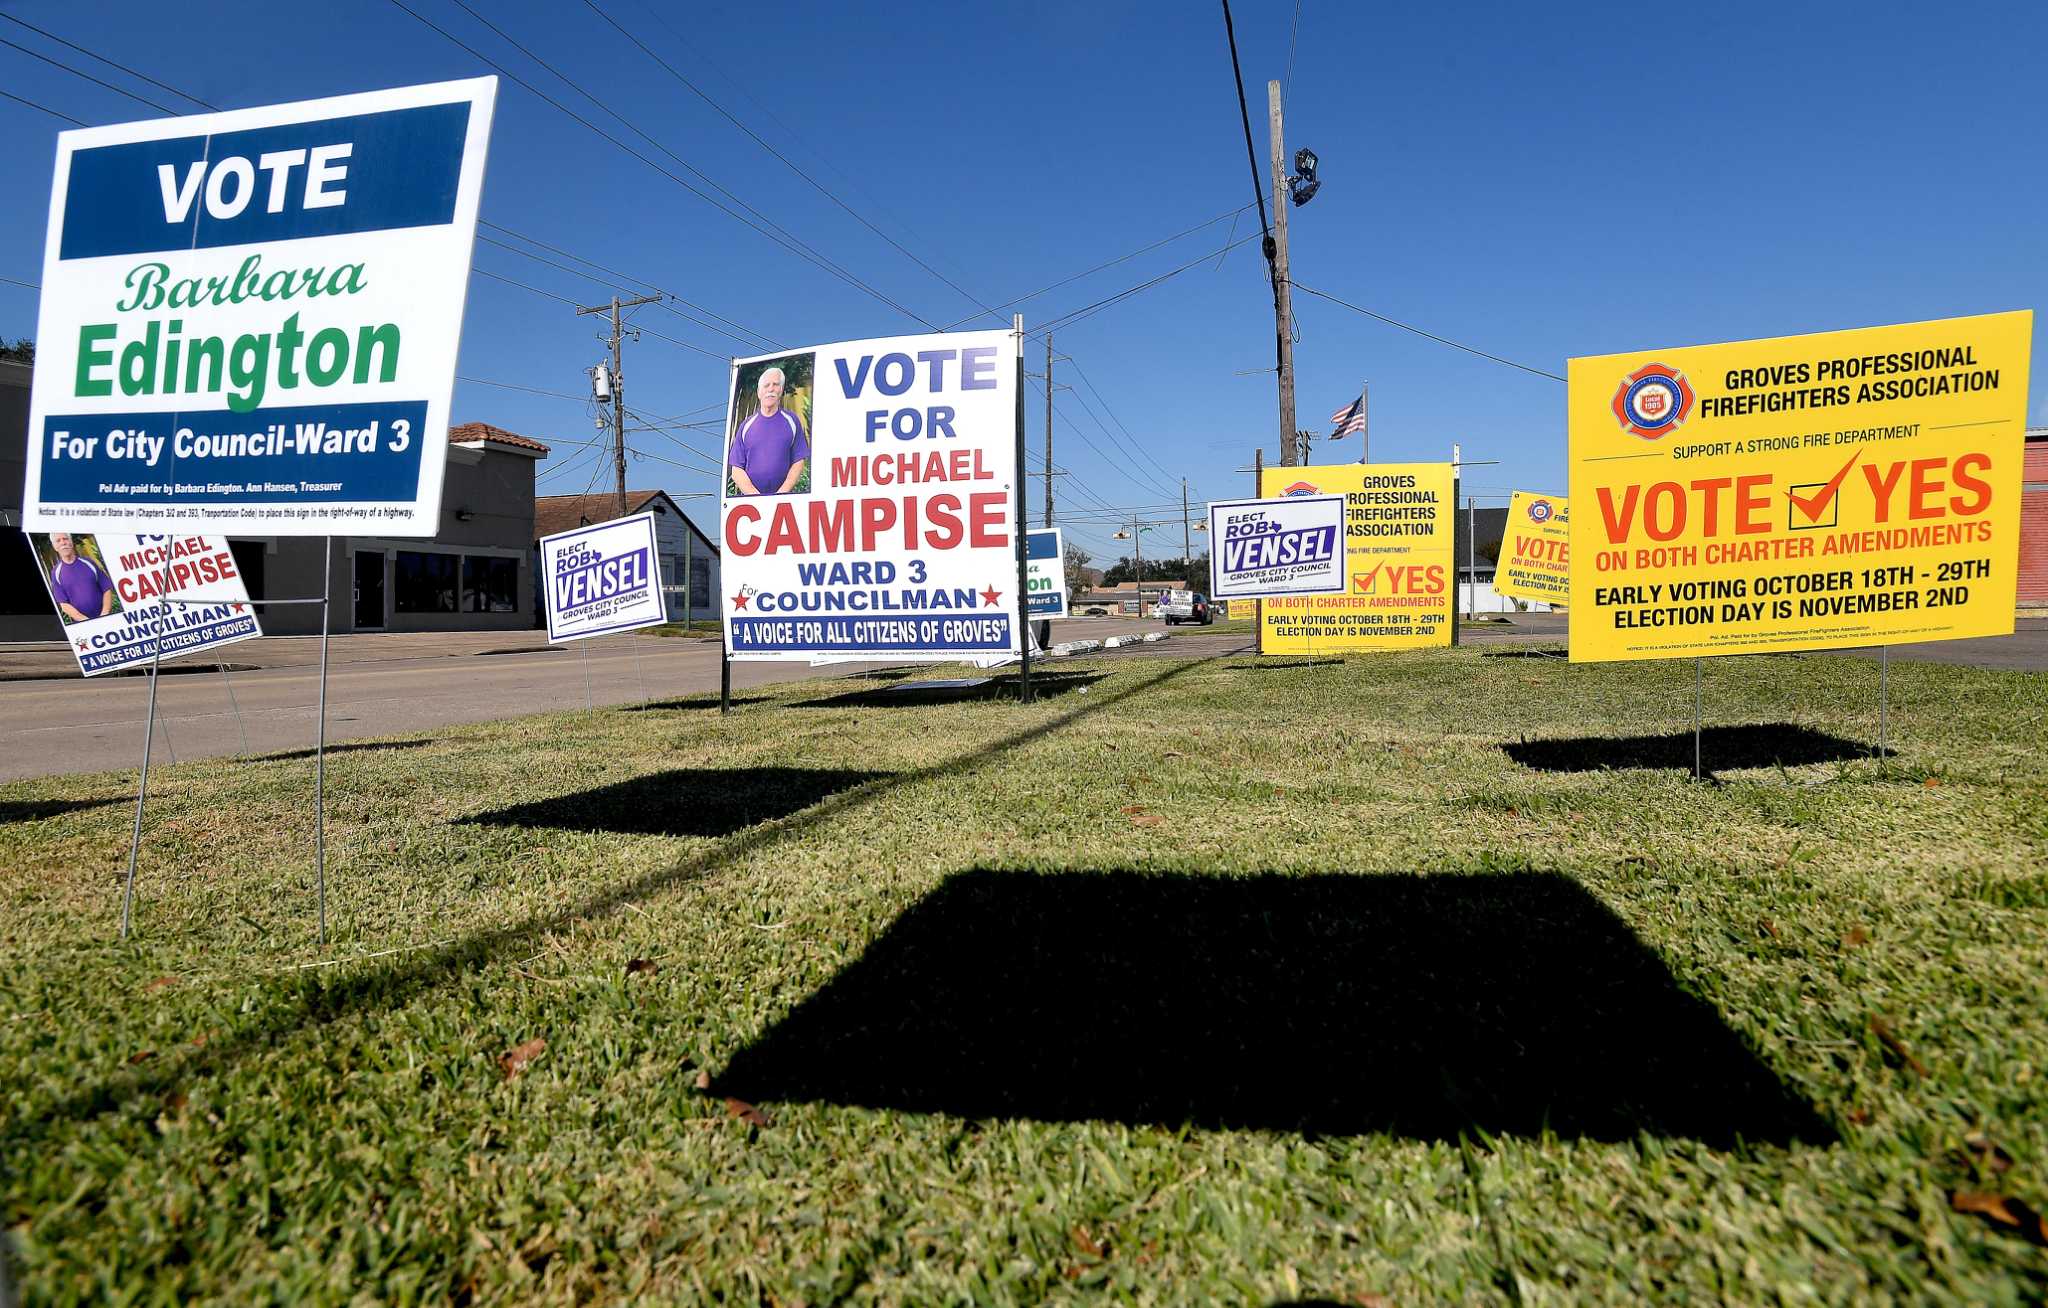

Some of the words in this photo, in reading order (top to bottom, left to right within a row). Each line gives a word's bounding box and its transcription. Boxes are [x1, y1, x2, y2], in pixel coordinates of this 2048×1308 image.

[158, 142, 352, 223] VOTE
[117, 254, 368, 312] Barbara
[75, 312, 401, 413] Edington
[834, 346, 997, 400] VOTE
[1725, 363, 1810, 390] GROVES
[1817, 346, 1977, 381] PROFESSIONAL
[1701, 385, 1850, 419] FIREFIGHTERS
[1856, 370, 2000, 404] ASSOCIATION
[865, 406, 957, 443] FOR
[52, 430, 99, 459] For
[106, 429, 165, 466] City
[174, 420, 378, 458] Council-Ward
[389, 419, 411, 452] 3
[1673, 442, 1732, 460] SUPPORT
[1734, 441, 1744, 454] A
[1747, 436, 1800, 453] STRONG
[1803, 433, 1831, 448] FIRE
[1834, 424, 1921, 445] DEPARTMENT
[831, 449, 994, 488] MICHAEL
[1363, 475, 1415, 489] GROVES
[130, 484, 149, 495] paid
[150, 484, 162, 493] for
[163, 484, 173, 495] by
[174, 483, 206, 493] Barbara
[246, 482, 262, 492] Ann
[300, 481, 343, 492] Treasurer
[1345, 491, 1439, 505] ROFESSIONAL
[1595, 473, 1773, 545] VOTE
[1861, 452, 1993, 524] YES
[266, 508, 282, 519] place
[283, 508, 295, 517] this
[296, 507, 309, 520] sign
[311, 507, 317, 517] in
[318, 507, 329, 517] the
[330, 506, 367, 519] right-of-way
[369, 507, 376, 517] of
[378, 509, 383, 517] a
[384, 506, 415, 519] highway.
[725, 491, 1009, 557] CAMPISE
[1227, 512, 1266, 525] ELECT
[1226, 521, 1268, 538] ROB
[1346, 523, 1434, 537] ASSOCIATION
[119, 535, 213, 572] MICHAEL
[557, 541, 588, 559] ELECT
[1226, 529, 1331, 571] VENSEL
[1516, 535, 1569, 563] VOTE
[1595, 551, 1627, 572] ON
[1635, 546, 1697, 570] BOTH
[1705, 537, 1814, 565] CHARTER
[1821, 520, 1992, 556] AMENDMENTS
[556, 551, 592, 574] ROB
[798, 560, 896, 586] WARD
[908, 560, 928, 584] 3
[1230, 570, 1266, 581] GROVES
[1269, 567, 1289, 577] CITY
[1291, 563, 1331, 574] COUNCIL
[1508, 568, 1531, 579] EARLY
[1532, 572, 1558, 584] VOTING
[1511, 557, 1523, 566] ON
[1524, 560, 1545, 569] BOTH
[1547, 562, 1568, 573] CHAR
[117, 552, 237, 603] CAMPISE
[557, 553, 647, 611] VENSEL
[1258, 575, 1286, 585] WARD
[1289, 574, 1294, 582] 3
[1385, 565, 1445, 594] YES
[1513, 579, 1547, 590] ELECTION
[1548, 583, 1563, 592] DAY
[1595, 584, 1663, 606] EARLY
[1669, 578, 1747, 601] VOTING
[1754, 570, 1853, 597] OCTOBER
[1861, 565, 1914, 589] 18TH
[1937, 559, 1990, 582] 29TH
[123, 602, 172, 625] WARD
[563, 603, 594, 620] GROVES
[595, 599, 613, 610] CITY
[614, 590, 649, 605] COUNCIL
[587, 609, 612, 621] WARD
[613, 606, 618, 615] 3
[756, 588, 977, 613] COUNCILMAN
[1268, 598, 1283, 609] ON
[1286, 598, 1313, 608] BOTH
[1317, 598, 1365, 608] CHARTER
[1369, 596, 1445, 607] AMENDMENTS
[1614, 605, 1714, 629] ELECTION
[1721, 601, 1767, 623] DAY
[1772, 600, 1792, 620] IS
[1799, 590, 1919, 618] NOVEMBER
[1926, 586, 1969, 608] 2ND
[91, 603, 231, 649] COUNCILMAN
[754, 622, 795, 643] VOICE
[796, 622, 824, 643] FOR
[825, 622, 852, 644] ALL
[855, 621, 918, 643] CITIZENS
[922, 621, 940, 642] OF
[1268, 615, 1298, 625] EARLY
[1301, 615, 1336, 625] VOTING
[1339, 615, 1383, 624] OCTOBER
[1388, 614, 1411, 624] 18TH
[1420, 614, 1445, 624] 29TH
[1276, 626, 1322, 636] ELECTION
[1325, 627, 1344, 636] DAY
[1348, 626, 1357, 636] IS
[1359, 626, 1412, 636] NOVEMBER
[1415, 626, 1435, 635] 2ND
[96, 650, 125, 666] VOICE
[124, 646, 143, 659] FOR
[144, 642, 158, 655] ALL
[161, 631, 202, 650] CITIZENS
[202, 628, 214, 640] OF
